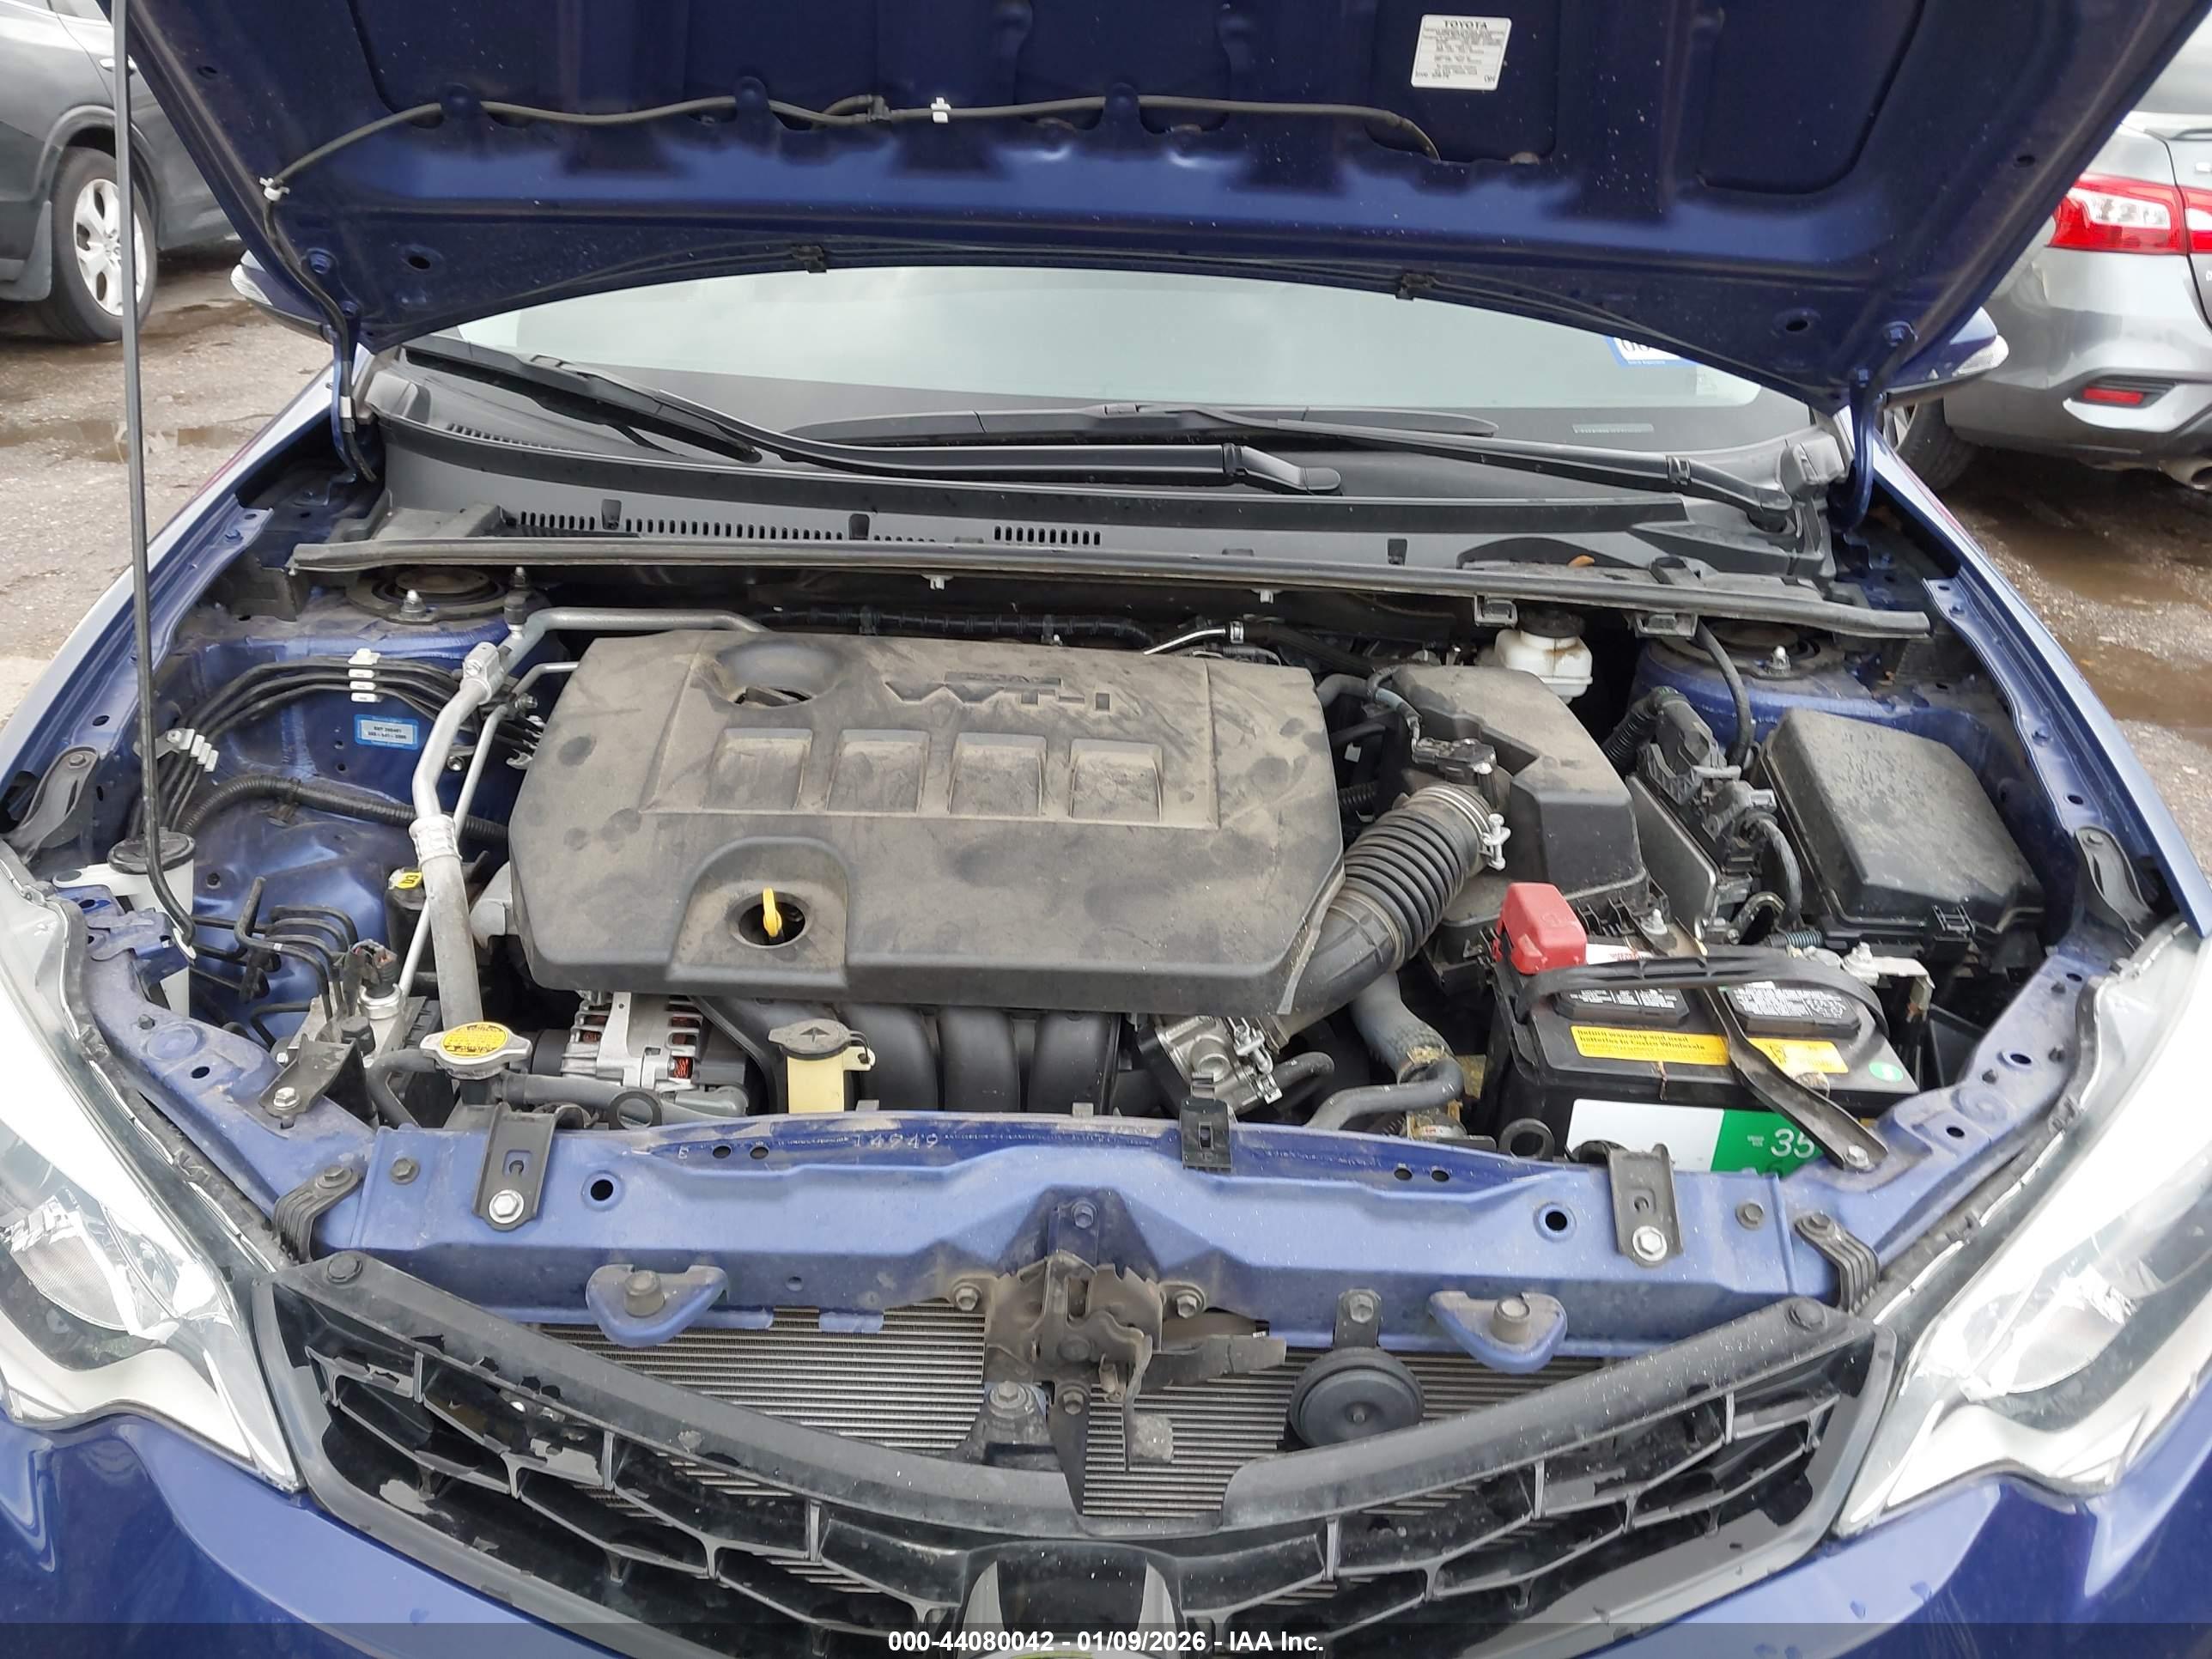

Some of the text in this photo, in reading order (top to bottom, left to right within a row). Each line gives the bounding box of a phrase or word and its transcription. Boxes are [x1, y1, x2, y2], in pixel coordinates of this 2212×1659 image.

[1443, 20, 1487, 29] TOYOTA
[1609, 1031, 1647, 1042] warranty
[1771, 1127, 1815, 1158] 35
